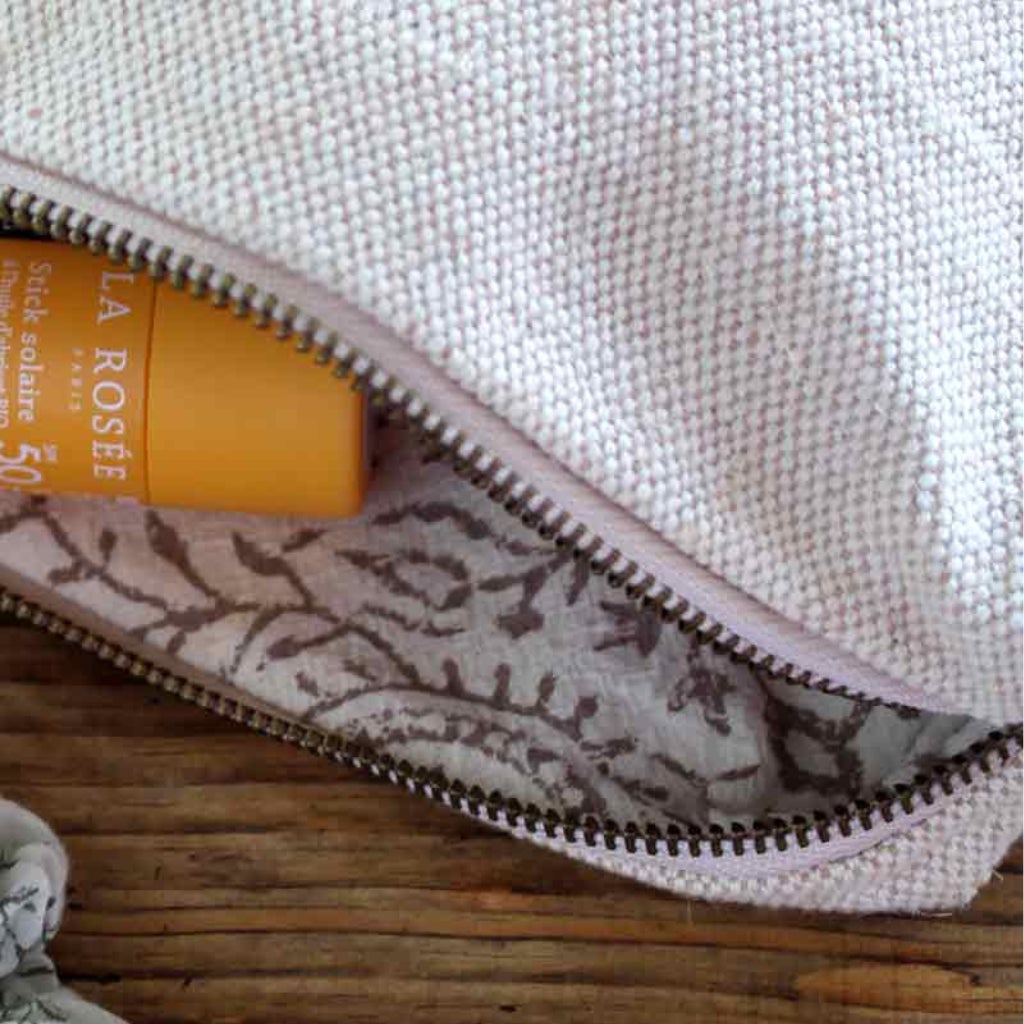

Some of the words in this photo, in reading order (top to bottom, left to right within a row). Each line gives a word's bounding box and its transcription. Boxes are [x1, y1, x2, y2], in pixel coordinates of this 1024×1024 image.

[22, 261, 52, 323] Stick
[96, 271, 134, 323] LA
[17, 332, 44, 424] solaire
[69, 347, 82, 412] PARIS
[92, 348, 132, 481] ROSÉE
